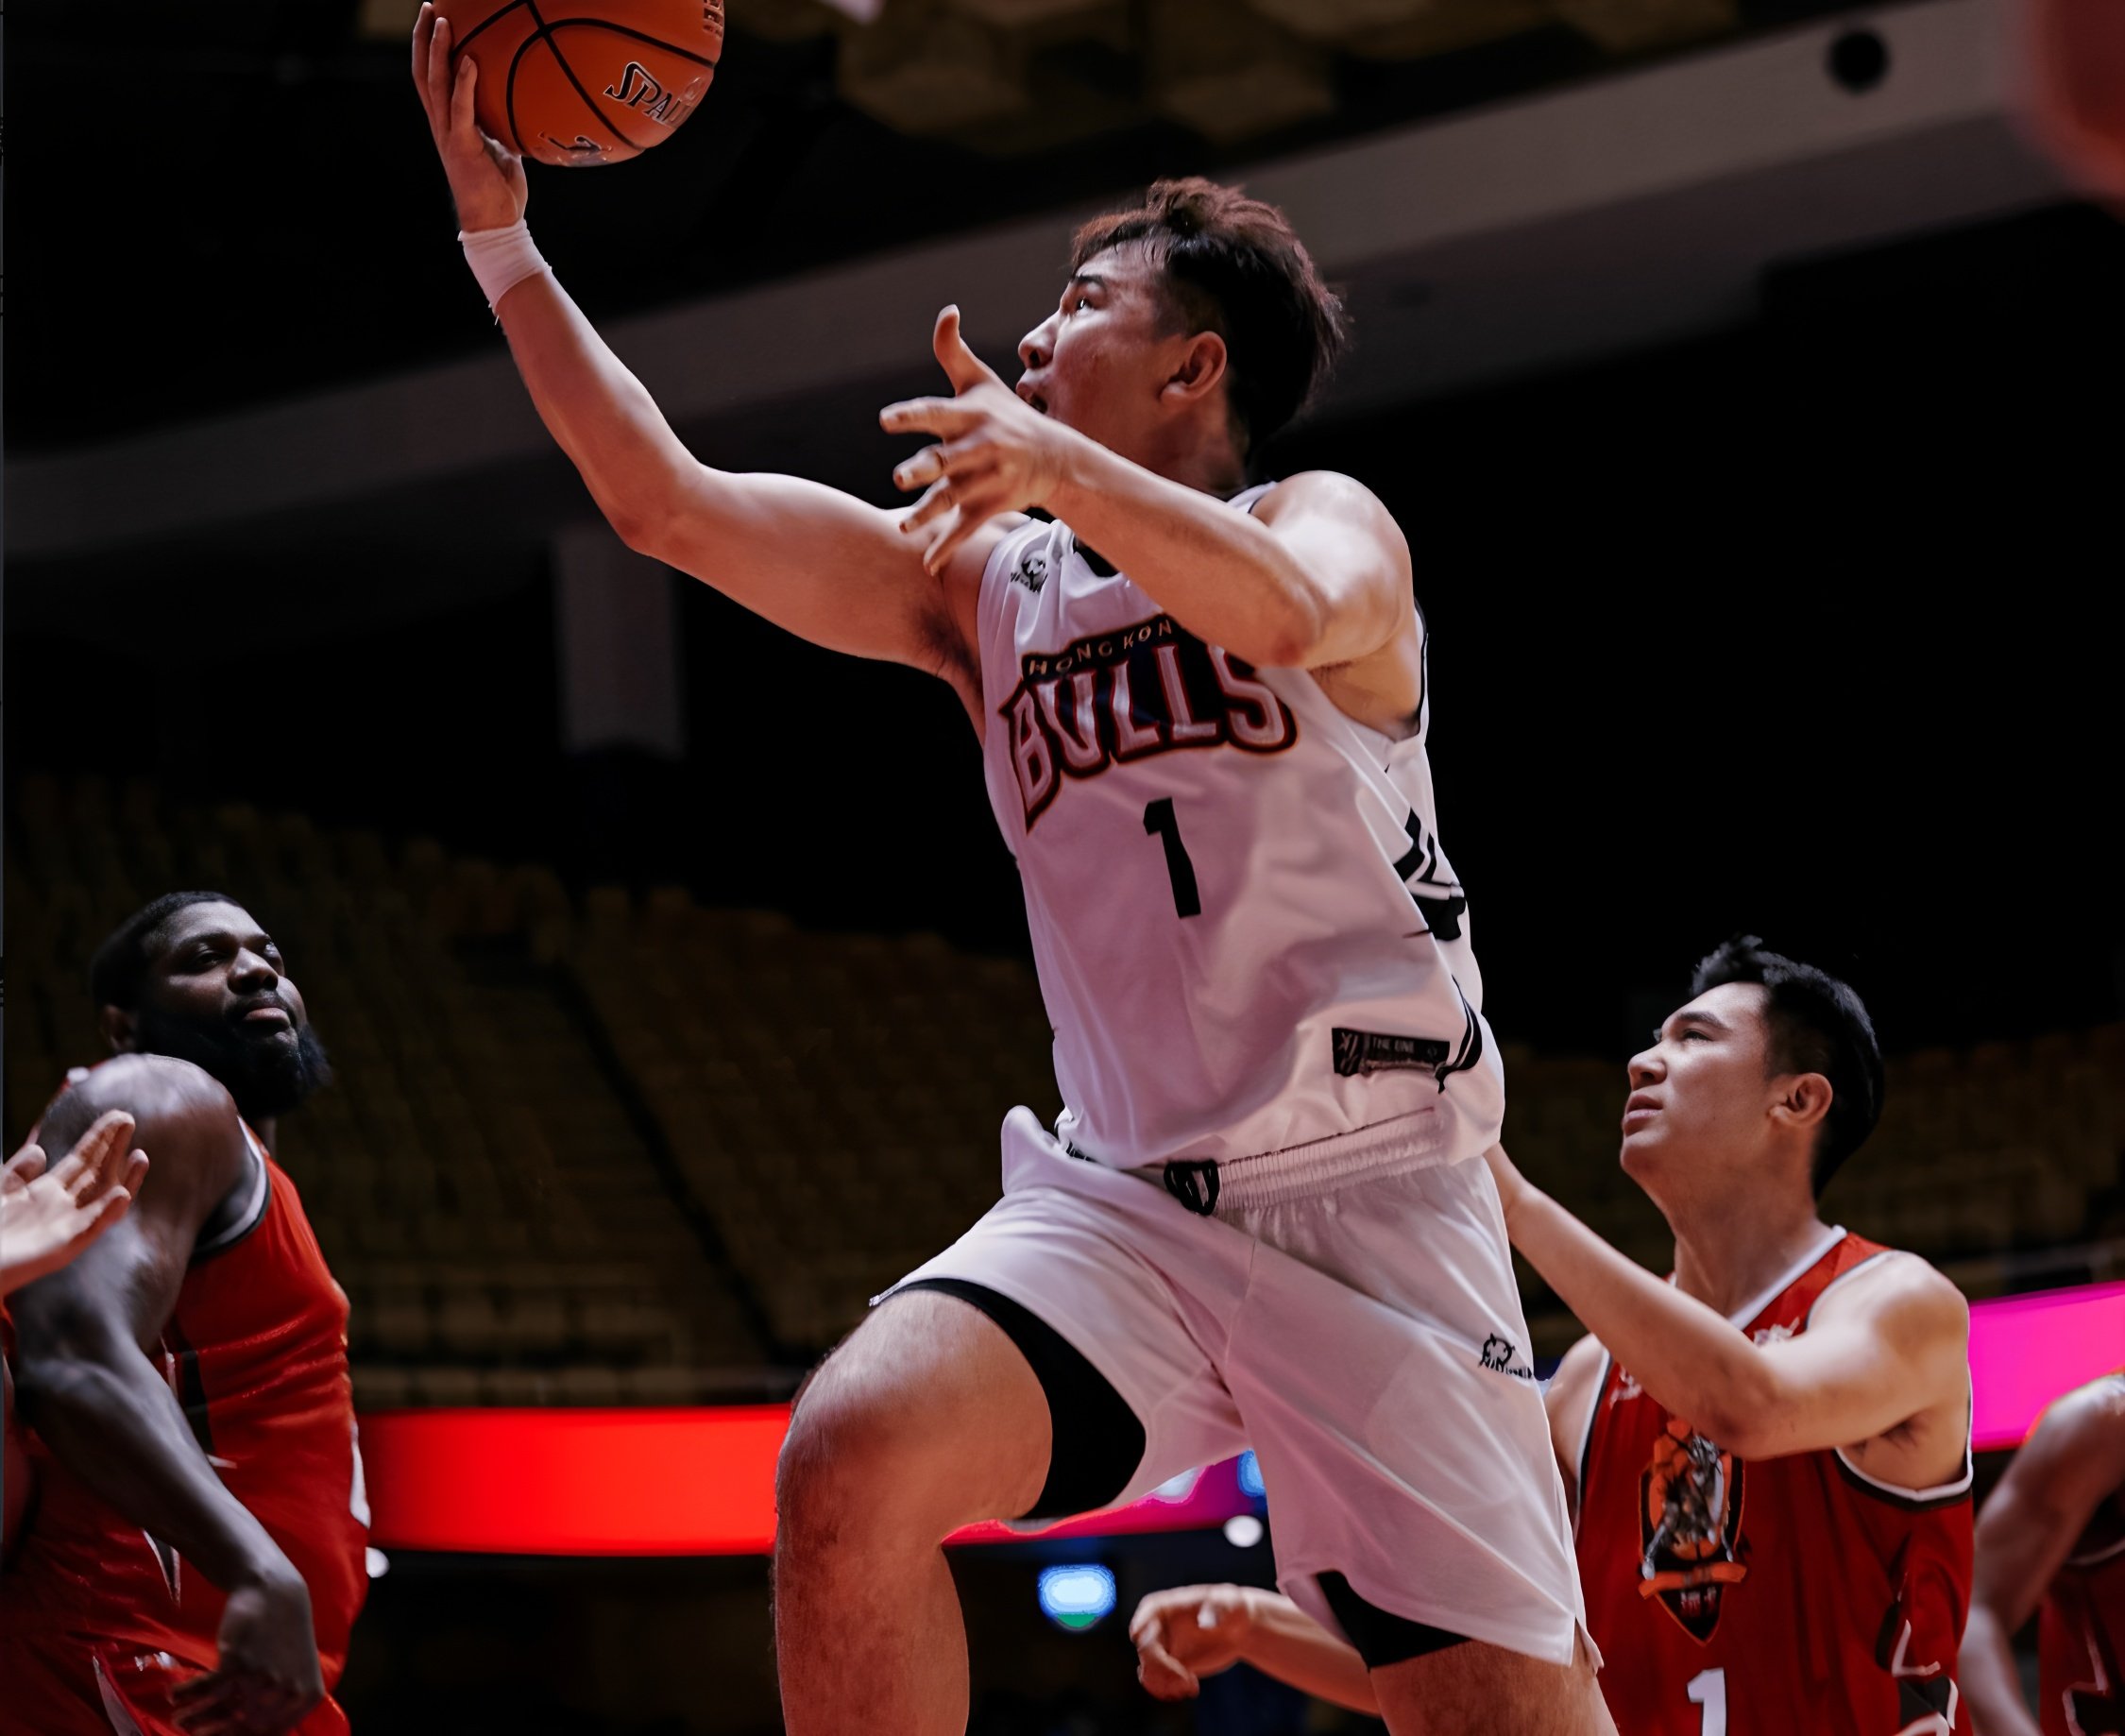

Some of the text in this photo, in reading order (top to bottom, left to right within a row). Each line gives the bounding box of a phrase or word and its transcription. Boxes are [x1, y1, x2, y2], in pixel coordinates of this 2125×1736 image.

[1028, 619, 1173, 676] HONG KON
[998, 644, 1300, 835] BULLS
[1143, 796, 1201, 920] 1
[1687, 1667, 1726, 1736] 1
